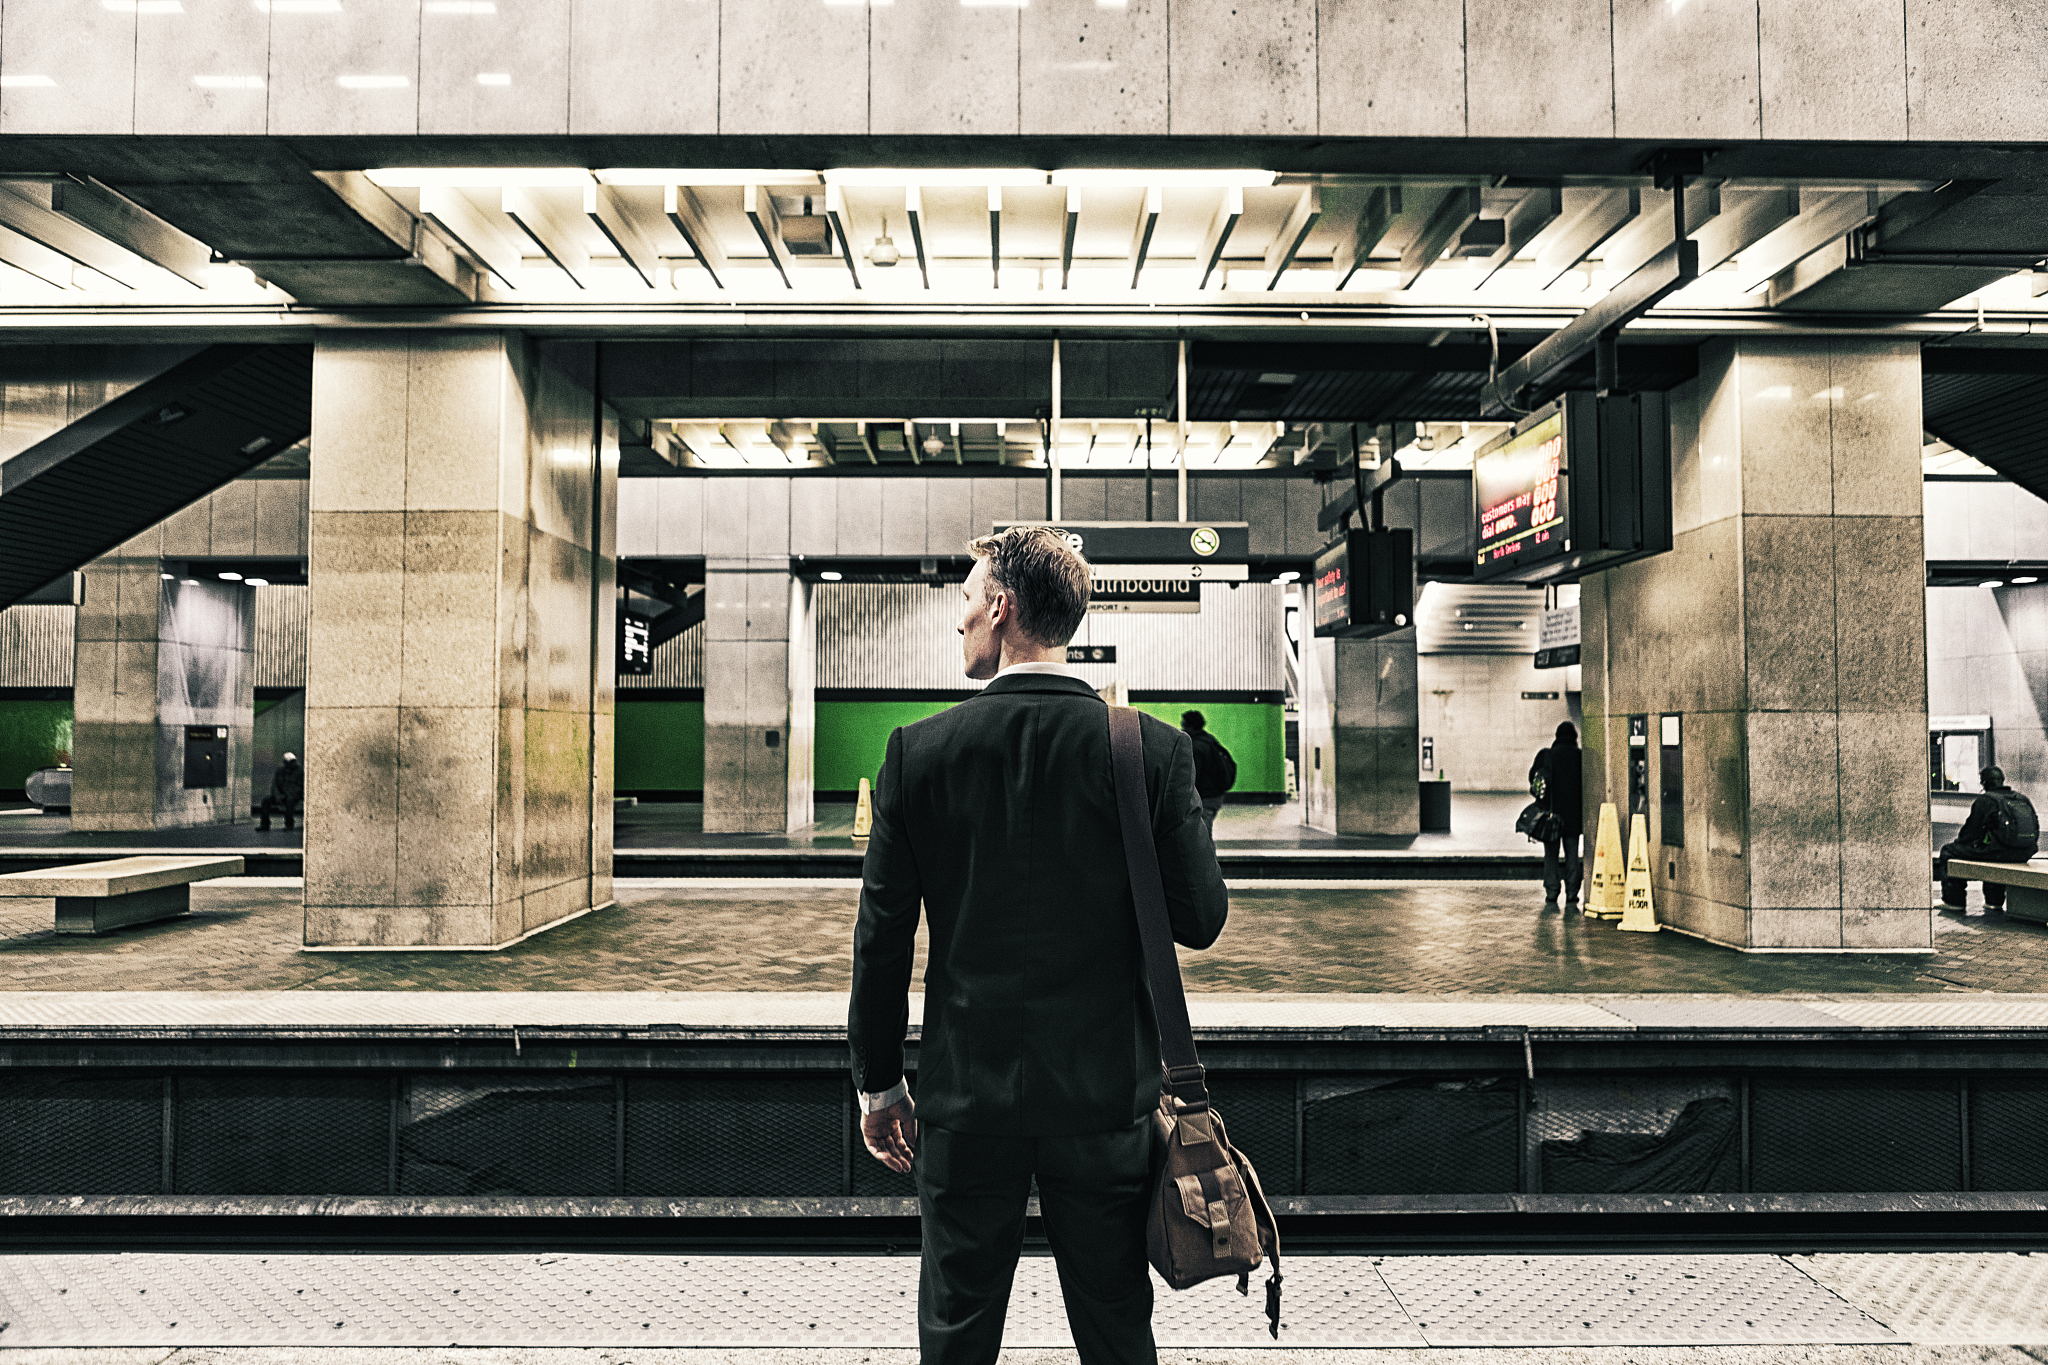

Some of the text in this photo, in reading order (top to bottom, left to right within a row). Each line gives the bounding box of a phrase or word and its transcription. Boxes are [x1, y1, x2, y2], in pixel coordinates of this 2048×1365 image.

[1481, 492, 1531, 524] customers may
[1482, 522, 1494, 540] dial
[1091, 580, 1190, 593] uthbound
[1633, 889, 1645, 898] WET
[1629, 900, 1648, 909] FLOOR
